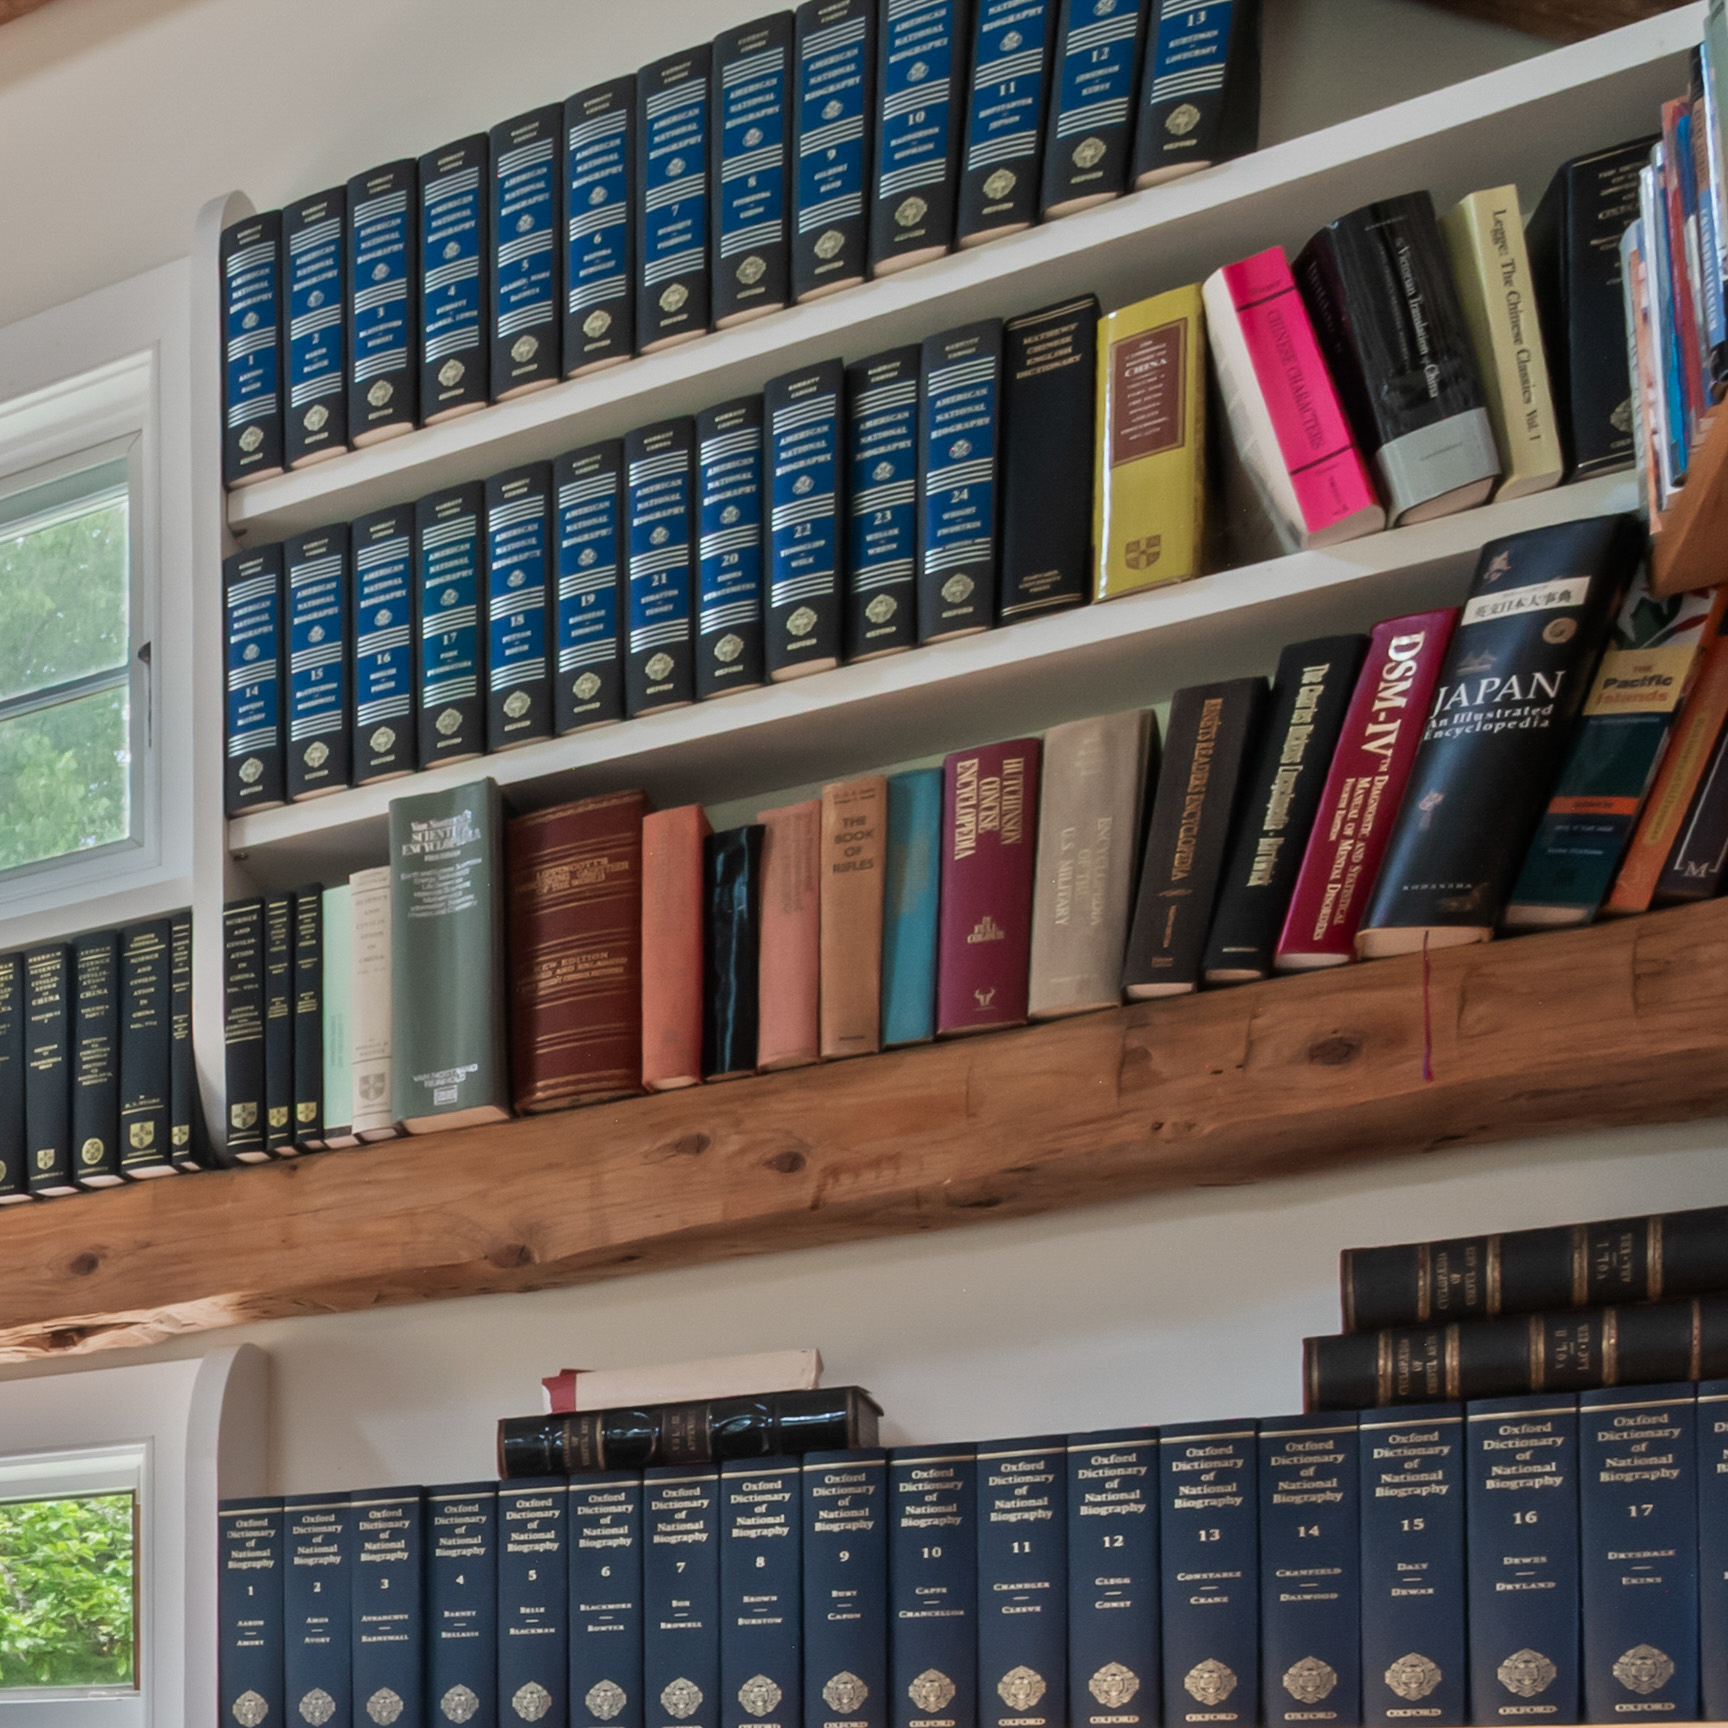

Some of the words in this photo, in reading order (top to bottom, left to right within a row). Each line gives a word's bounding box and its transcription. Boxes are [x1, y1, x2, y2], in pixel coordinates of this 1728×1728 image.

[1500, 258, 1517, 287] The
[1505, 289, 1524, 346] Chinese
[1515, 347, 1534, 405] Classics
[1431, 670, 1567, 717] JAPAN
[1452, 704, 1554, 724] Illustrated
[1424, 718, 1550, 740] Encyclopedia
[954, 757, 979, 860] ENCYCLOPEDIA
[1001, 757, 1024, 845] HUTCHINSON
[834, 830, 874, 842] BOOK
[844, 845, 863, 857] OF
[832, 858, 874, 875] RIFLES
[1499, 1421, 1552, 1436] Oxford
[1483, 1433, 1564, 1451] Dictionary
[1091, 1453, 1137, 1467] Oxford
[1515, 1449, 1534, 1461] of
[1078, 1463, 1147, 1480] Dictionary
[1491, 1460, 1556, 1477] National
[1106, 1478, 1120, 1489] of
[1486, 1474, 1563, 1490] Biography
[1086, 1489, 1141, 1503] National
[1080, 1501, 1146, 1516] Biography
[1513, 1511, 1538, 1525] 16
[1103, 1534, 1124, 1548] 12
